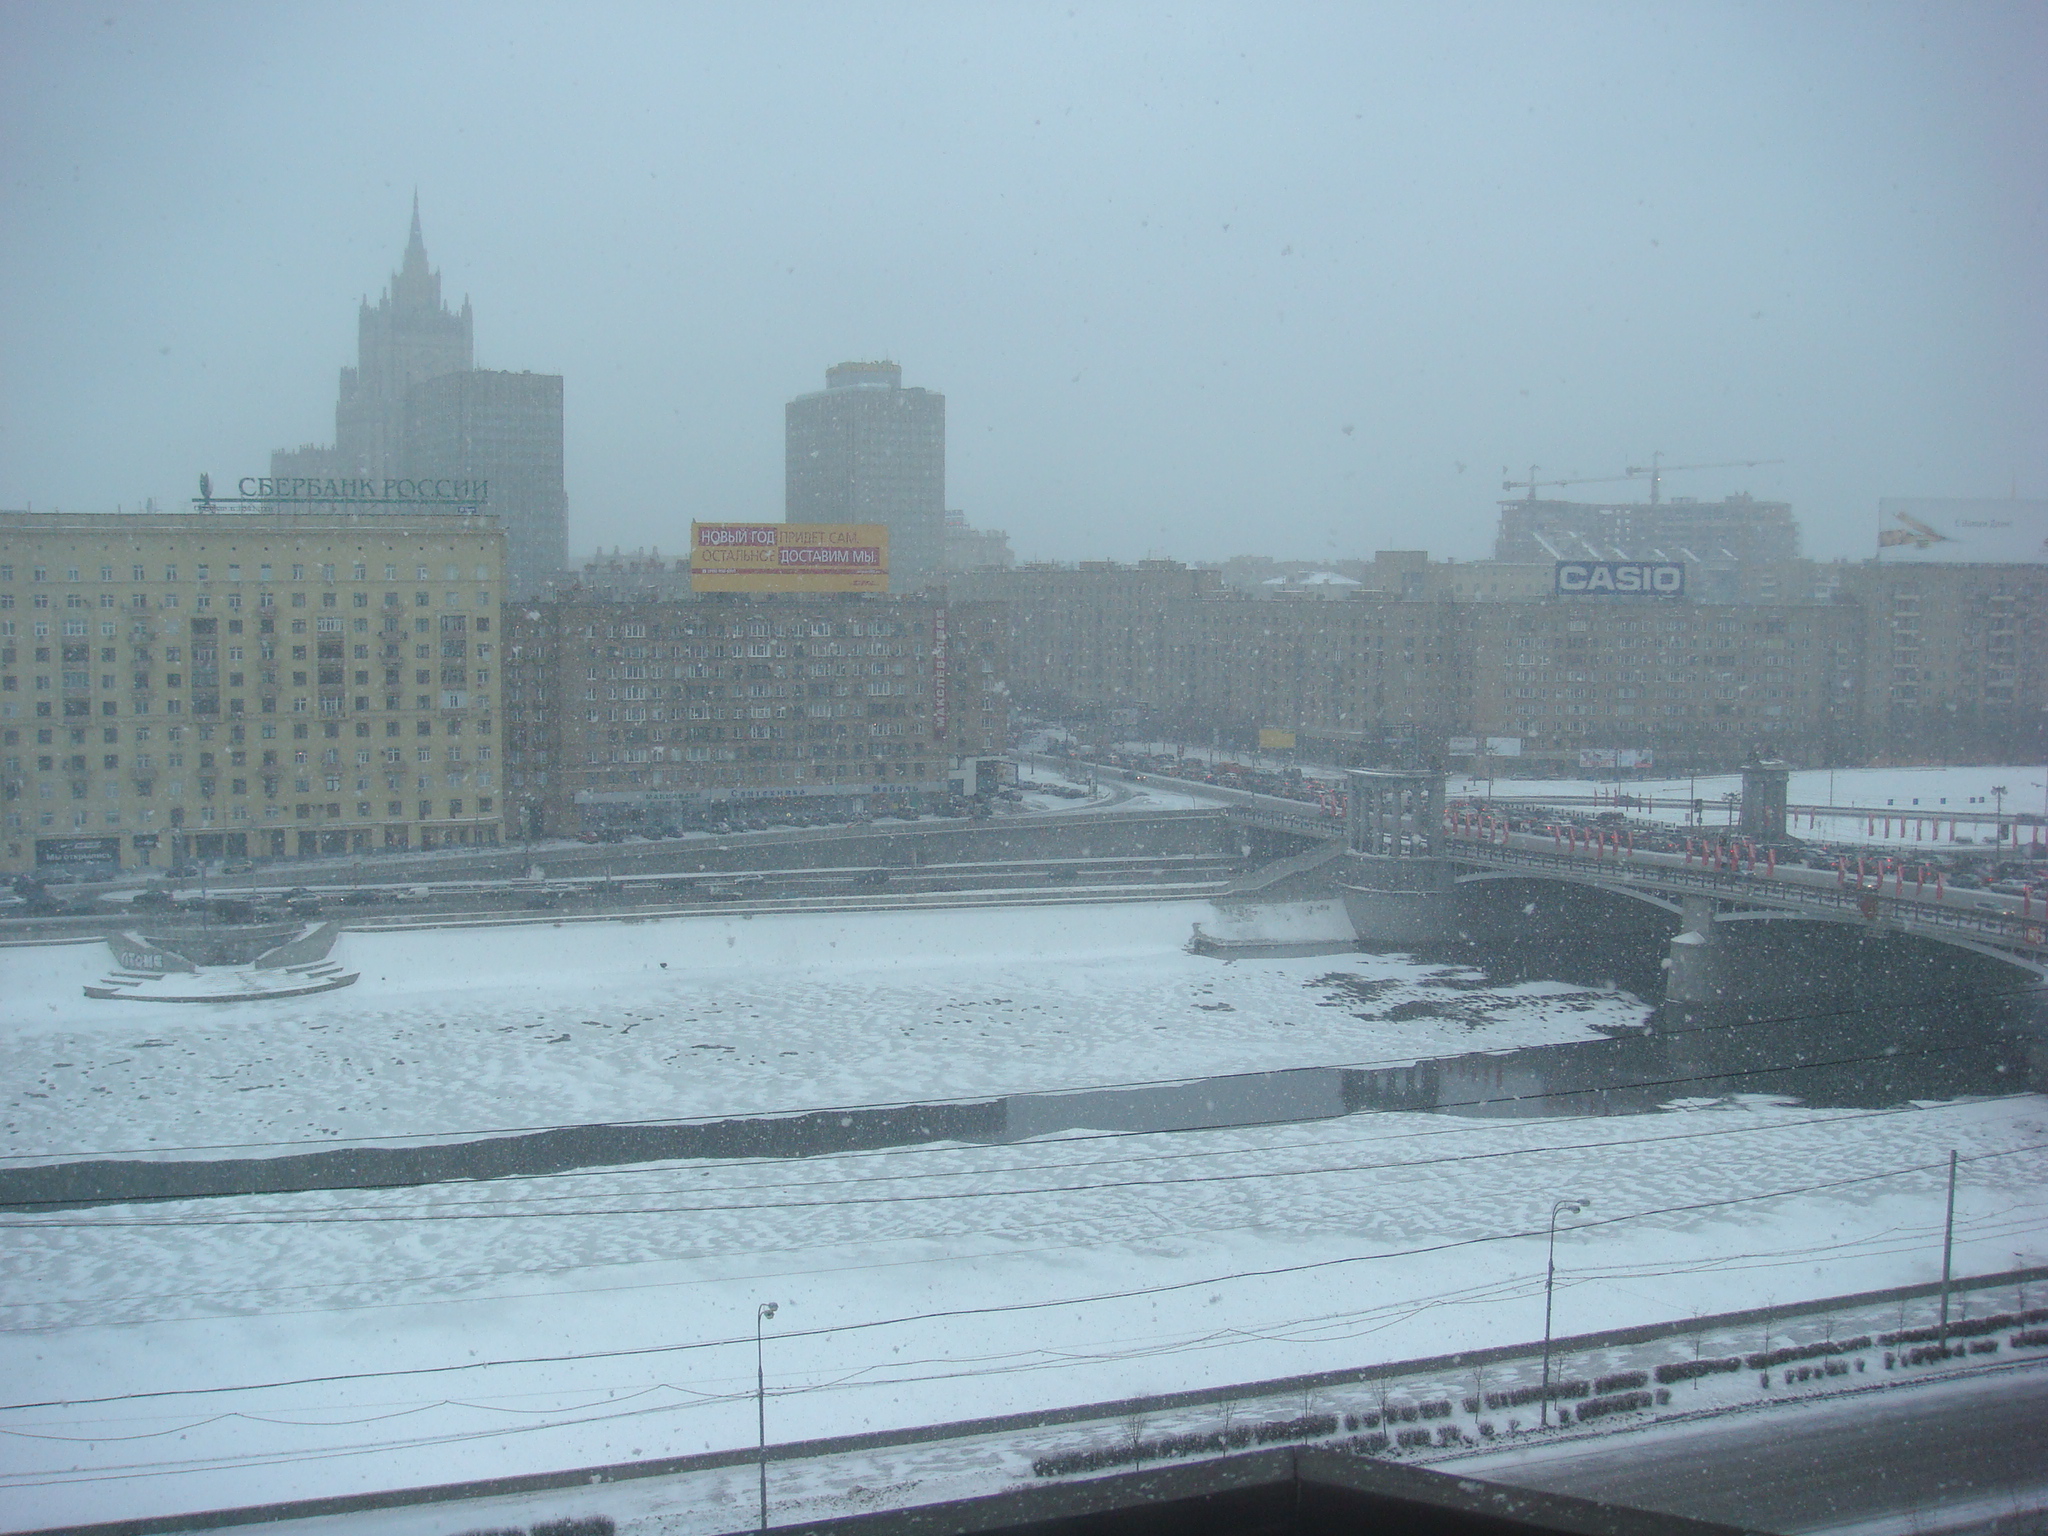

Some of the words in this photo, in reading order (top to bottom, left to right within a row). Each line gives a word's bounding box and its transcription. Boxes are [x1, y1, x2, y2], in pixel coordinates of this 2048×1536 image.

[238, 477, 376, 498] СБЕРБАНК
[383, 478, 488, 498] РОССИИ
[701, 528, 748, 544] НОВЫЙ
[751, 530, 775, 545] ГОД
[780, 531, 825, 544] ПРИДЕТ
[702, 549, 775, 562] ОСТАЛЬНОЕ
[779, 549, 849, 564] ДОСТАВИМ
[1560, 565, 1681, 591] CASIO
